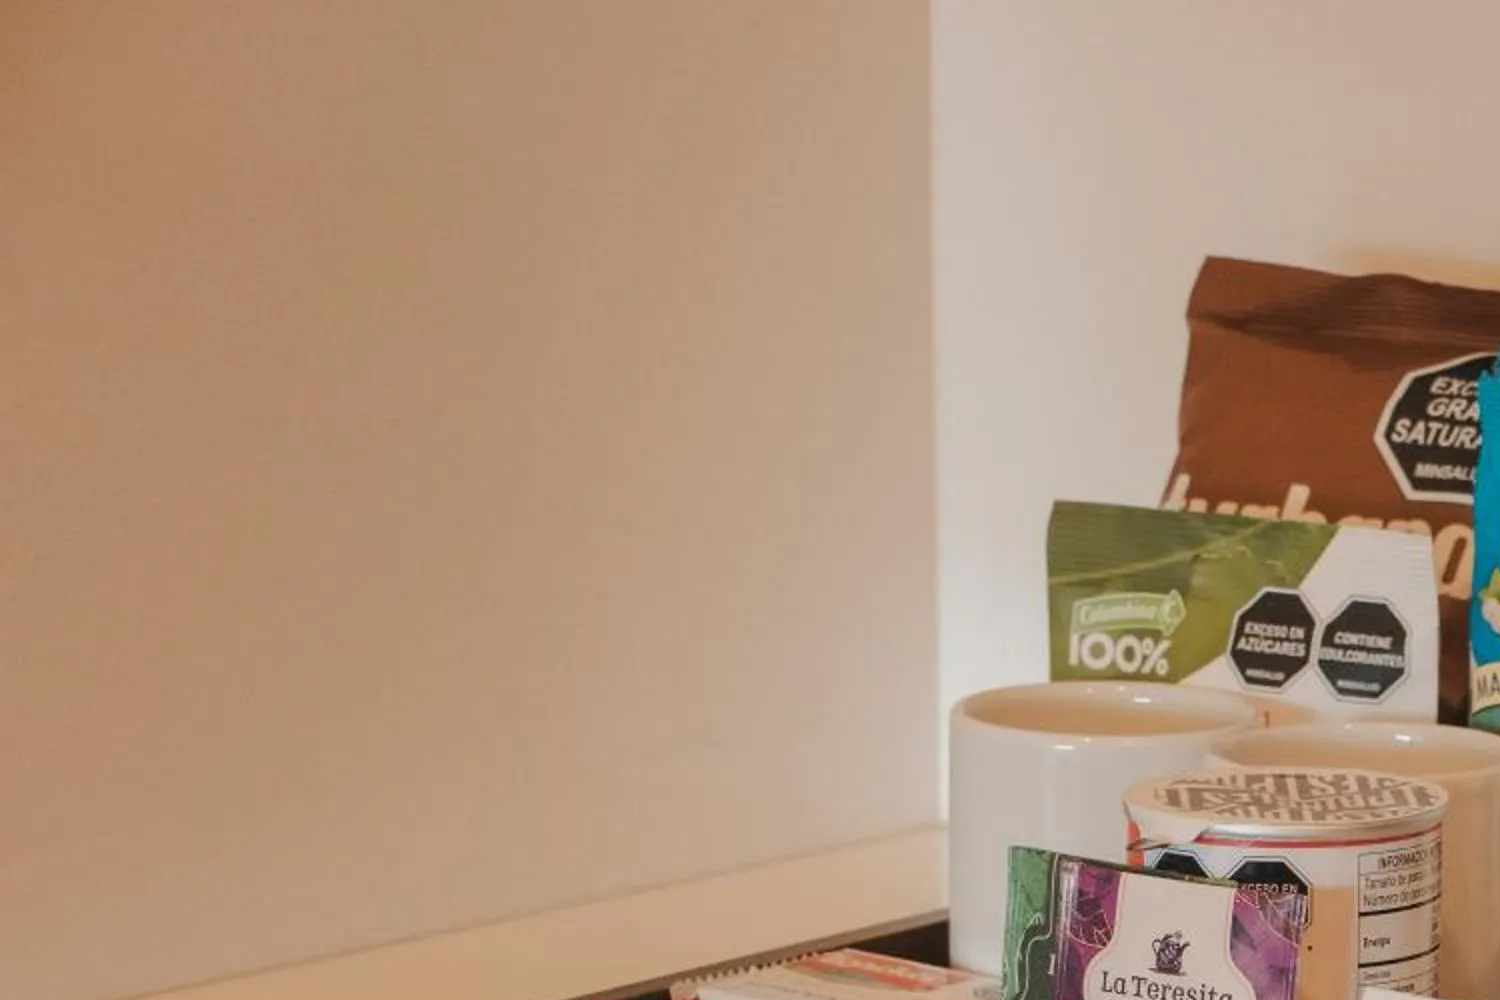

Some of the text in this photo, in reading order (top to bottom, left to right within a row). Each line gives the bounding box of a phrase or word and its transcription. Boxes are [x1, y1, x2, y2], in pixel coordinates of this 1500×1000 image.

[1429, 376, 1479, 396] EXC
[1426, 397, 1480, 421] GRA
[1391, 418, 1481, 450] SATUR
[1333, 631, 1393, 650] CONTIENE
[1068, 631, 1172, 677] 100%
[1101, 970, 1127, 995] La
